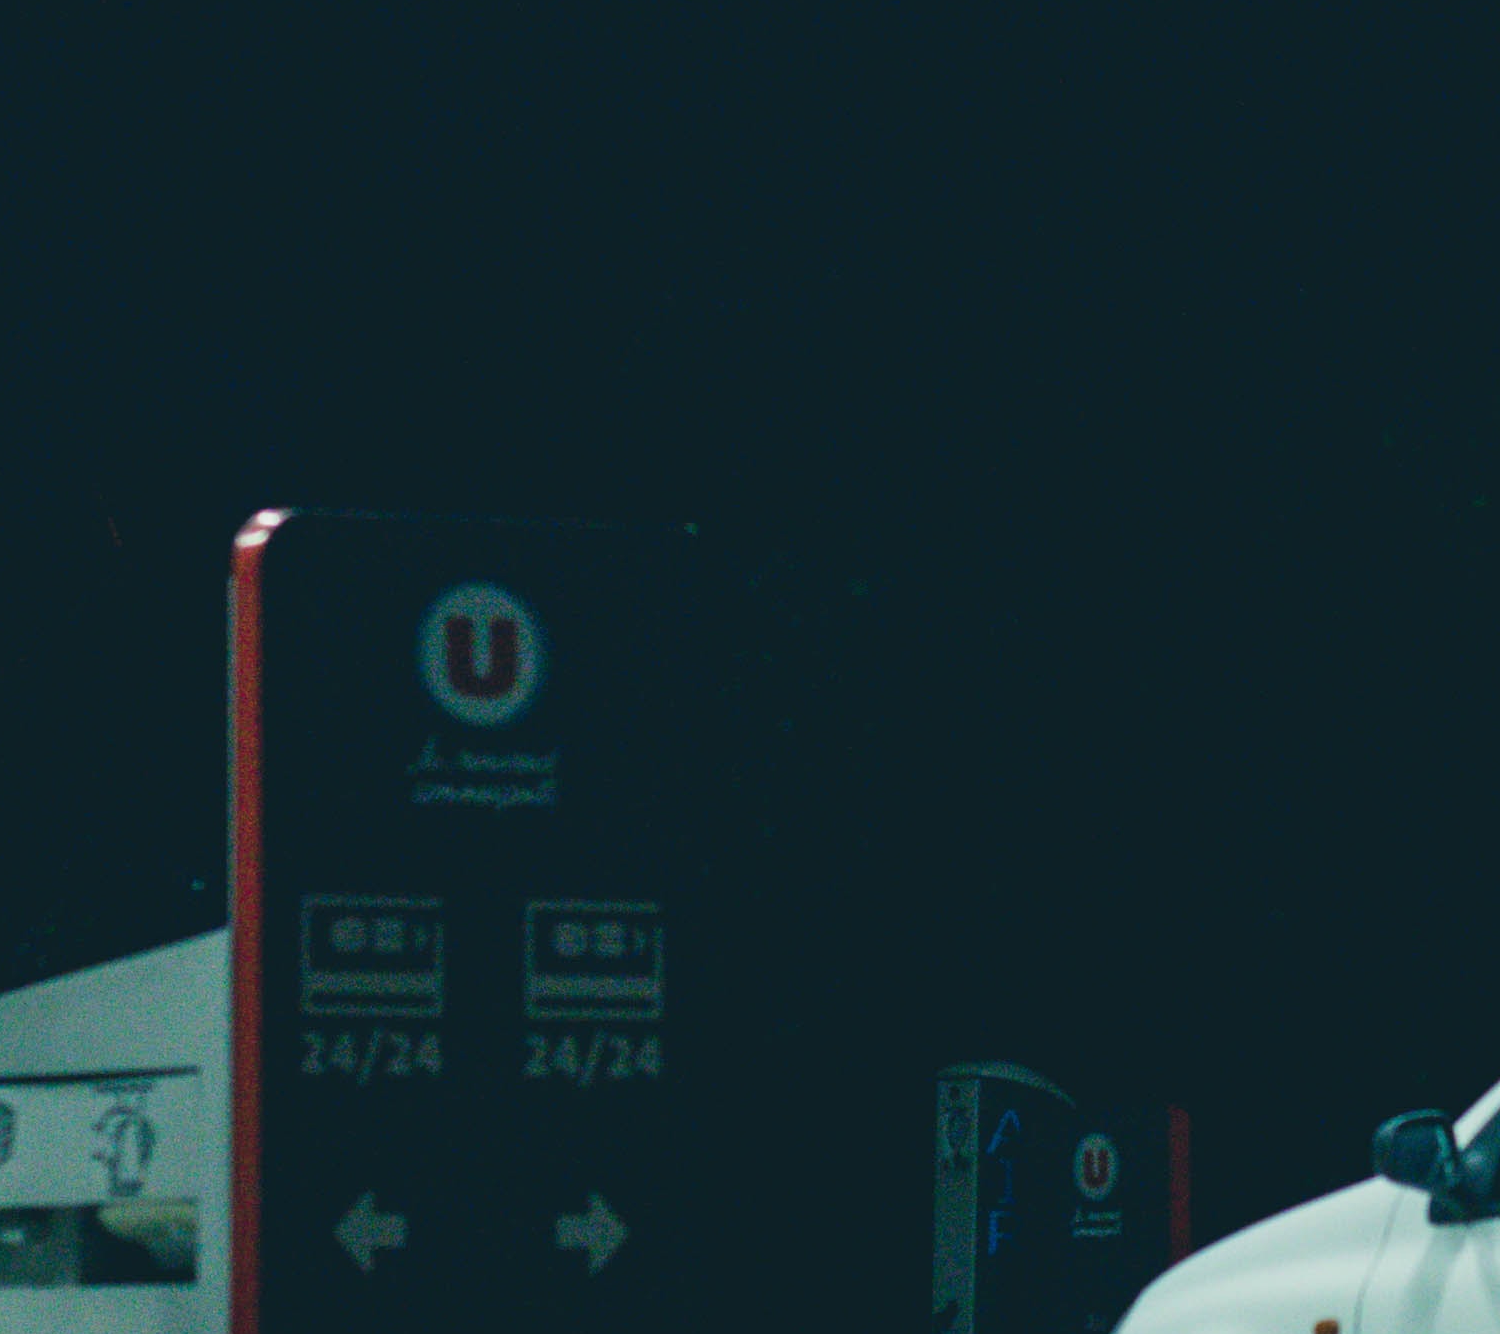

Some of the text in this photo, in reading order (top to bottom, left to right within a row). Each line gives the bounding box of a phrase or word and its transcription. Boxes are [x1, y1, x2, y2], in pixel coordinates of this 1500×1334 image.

[444, 614, 519, 700] U
[300, 1027, 444, 1087] 24/24
[522, 1029, 663, 1088] 24/24
